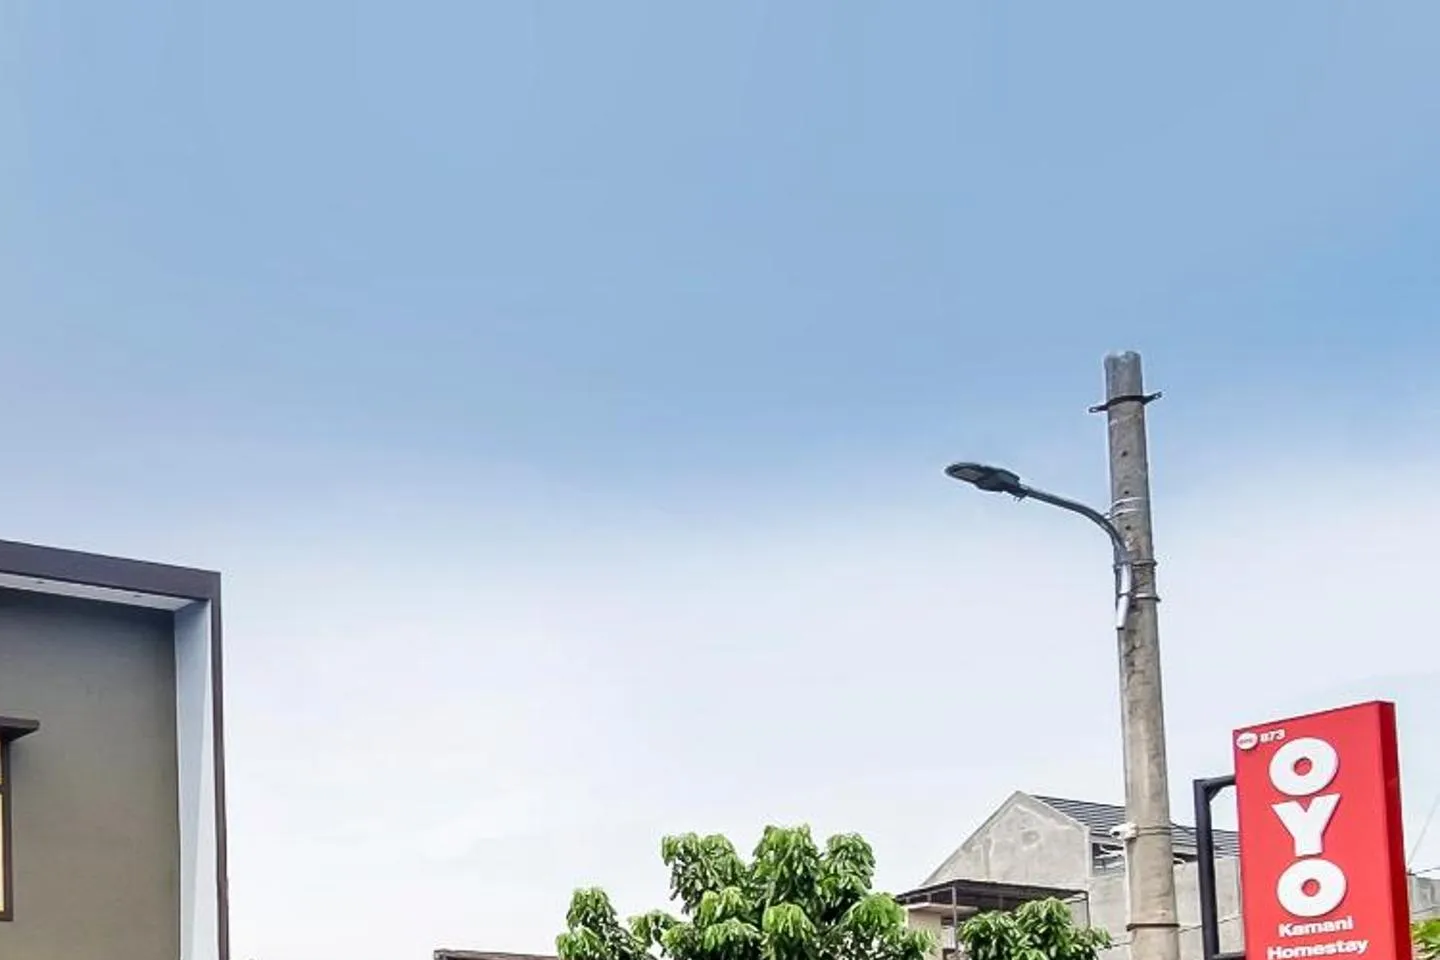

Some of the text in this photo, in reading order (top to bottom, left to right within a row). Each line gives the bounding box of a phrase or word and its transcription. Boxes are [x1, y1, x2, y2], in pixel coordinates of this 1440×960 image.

[1268, 737, 1348, 918] OYO
[1278, 916, 1354, 937] Kamani
[1266, 938, 1369, 960] Homestay
